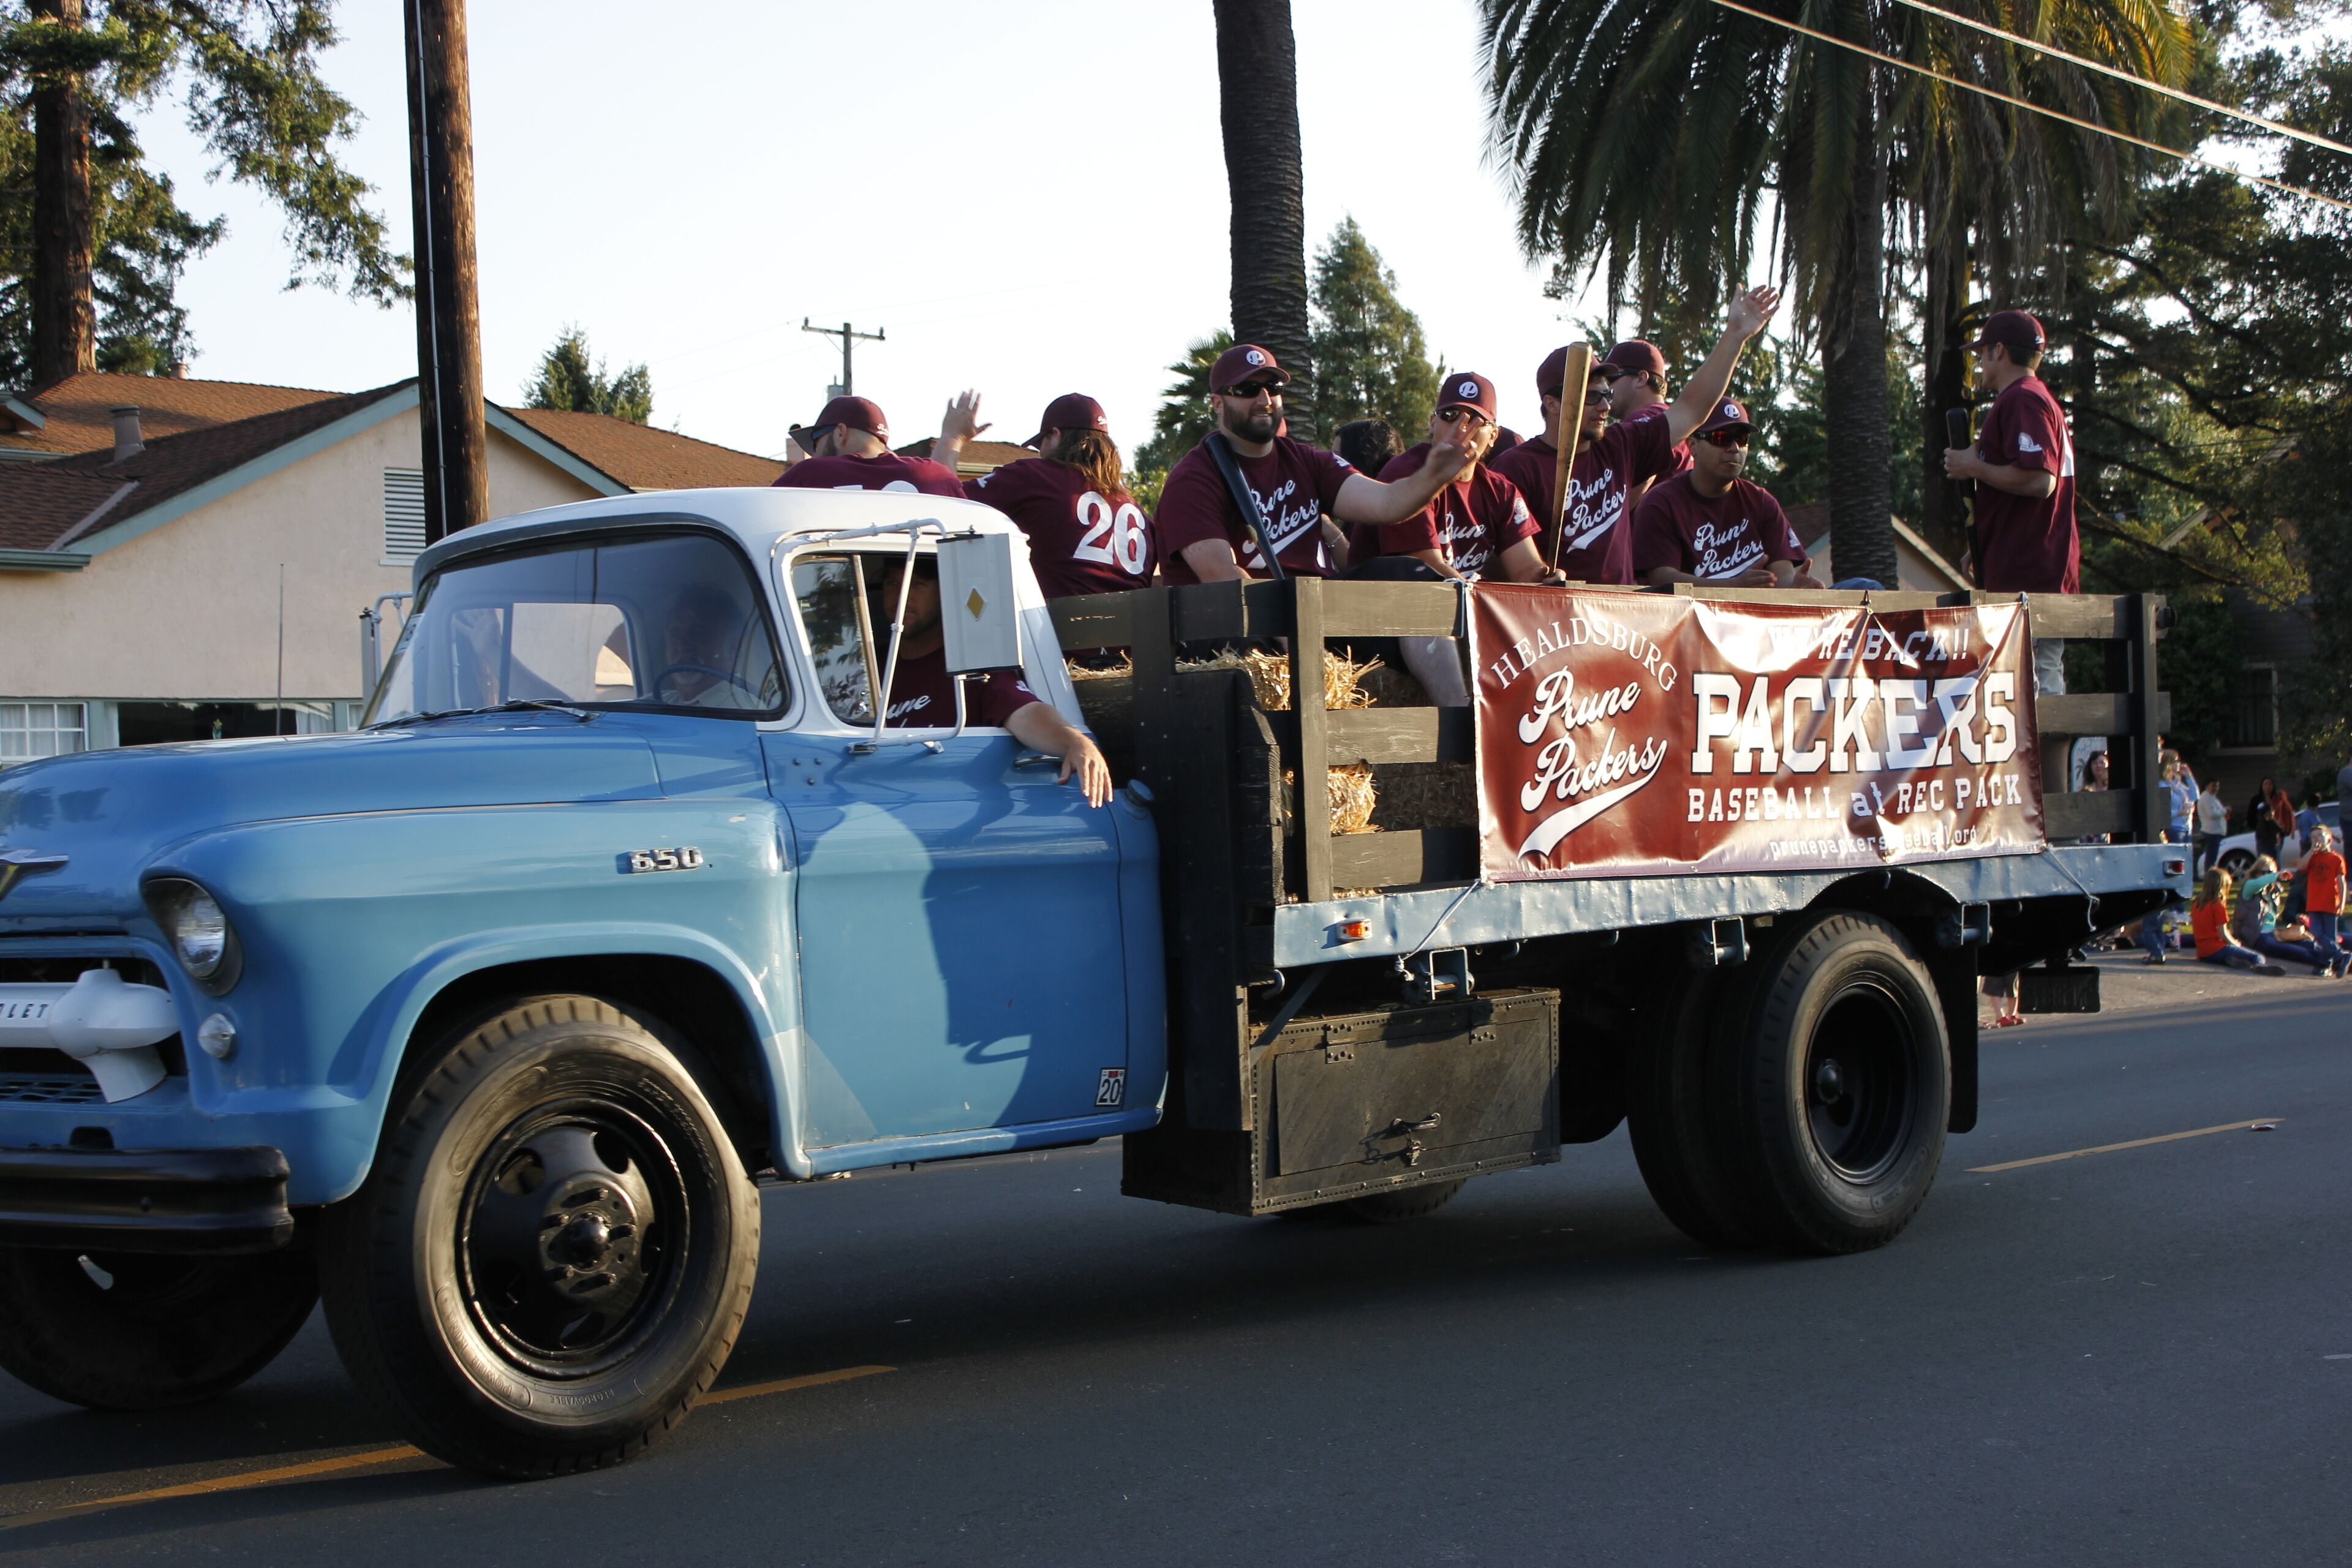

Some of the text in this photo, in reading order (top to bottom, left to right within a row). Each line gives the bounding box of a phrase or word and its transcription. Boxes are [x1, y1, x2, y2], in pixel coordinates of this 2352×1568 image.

[1072, 491, 1147, 575] 26
[1694, 518, 1749, 551] Prune
[1491, 617, 1678, 692] HEALDSBURG
[1518, 665, 1641, 744] Prune
[1691, 671, 2018, 775] PACKERS
[1520, 726, 1667, 812] Packers
[1687, 774, 2022, 823] BASEBALL at REC PACK
[631, 846, 704, 874] 650
[1098, 1078, 1120, 1104] 20
